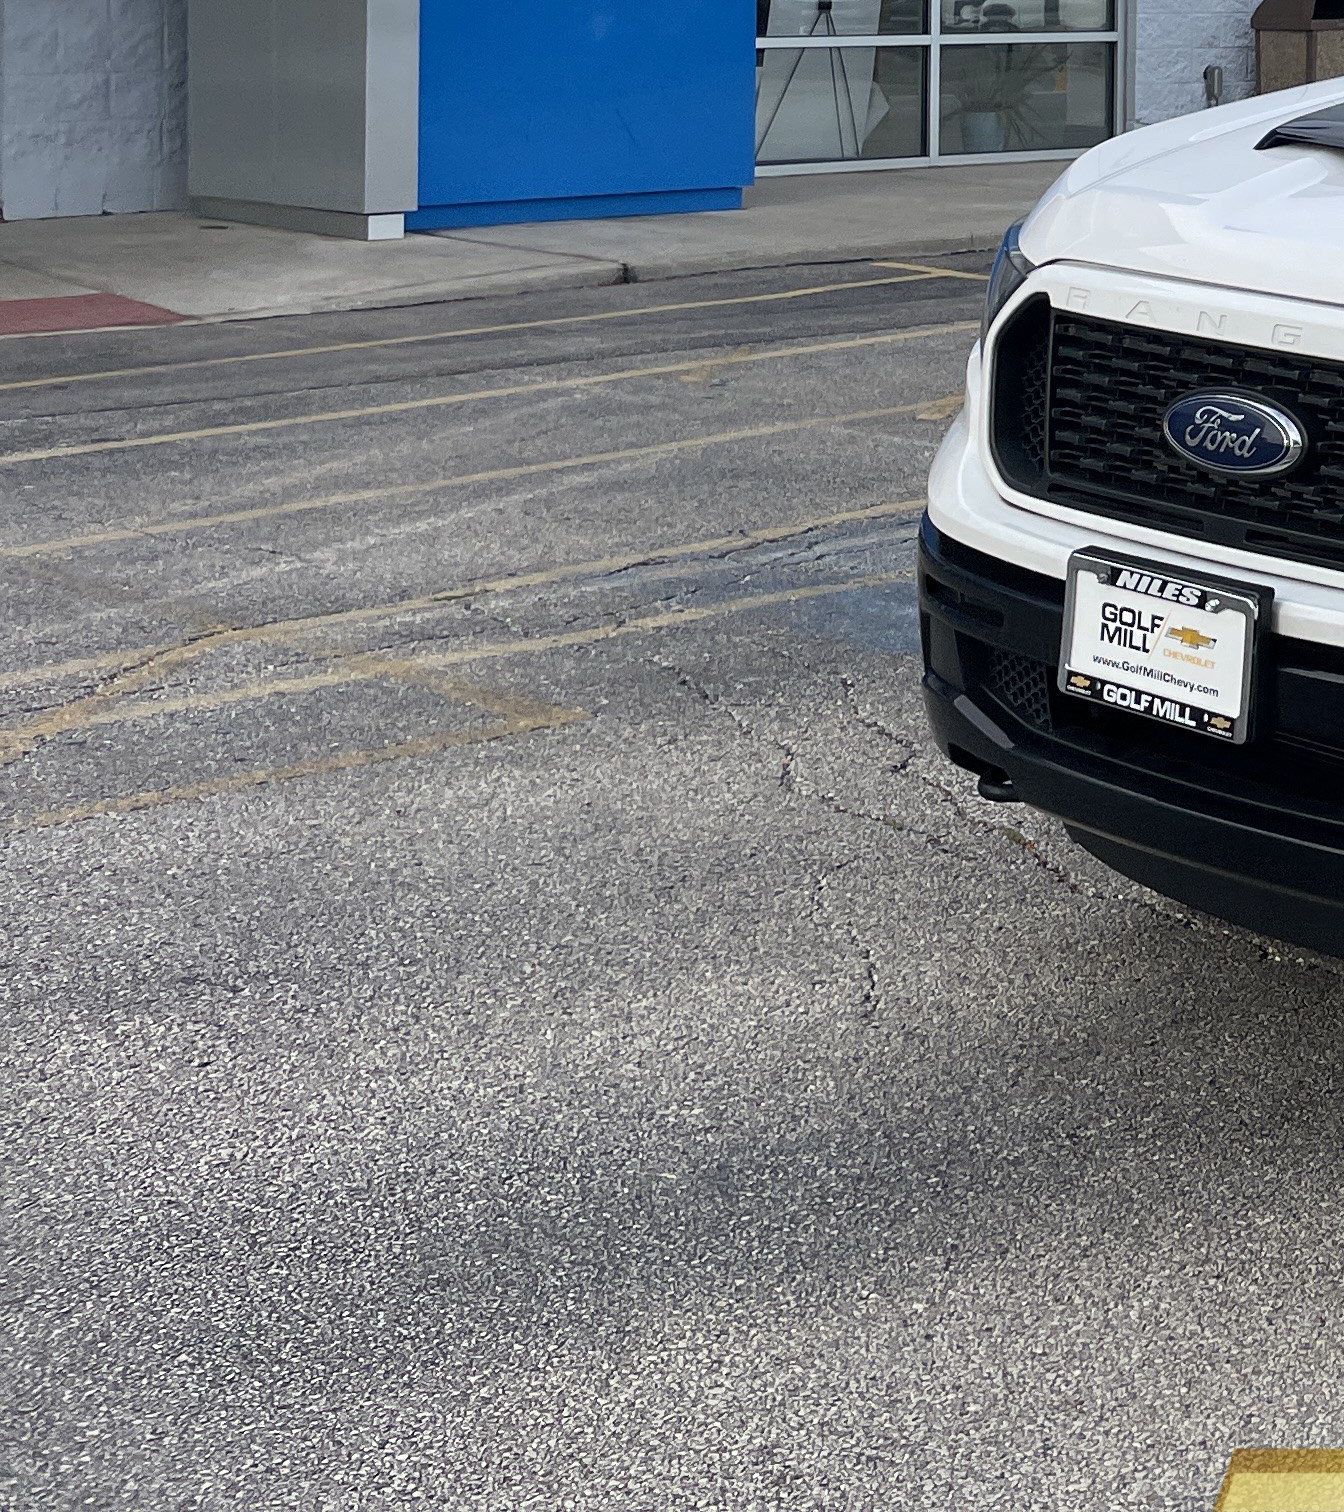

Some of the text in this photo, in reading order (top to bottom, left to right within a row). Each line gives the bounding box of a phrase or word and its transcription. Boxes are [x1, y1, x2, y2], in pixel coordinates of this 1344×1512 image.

[1184, 405, 1261, 459] Ford
[1115, 569, 1202, 607] NILES
[1101, 602, 1164, 634] GOLF
[1100, 623, 1150, 654] MILL
[1093, 654, 1219, 698] www.GolfMillChevy.com
[1162, 648, 1216, 670] CHEVROLET
[1103, 684, 1197, 727] GOLF MILL
